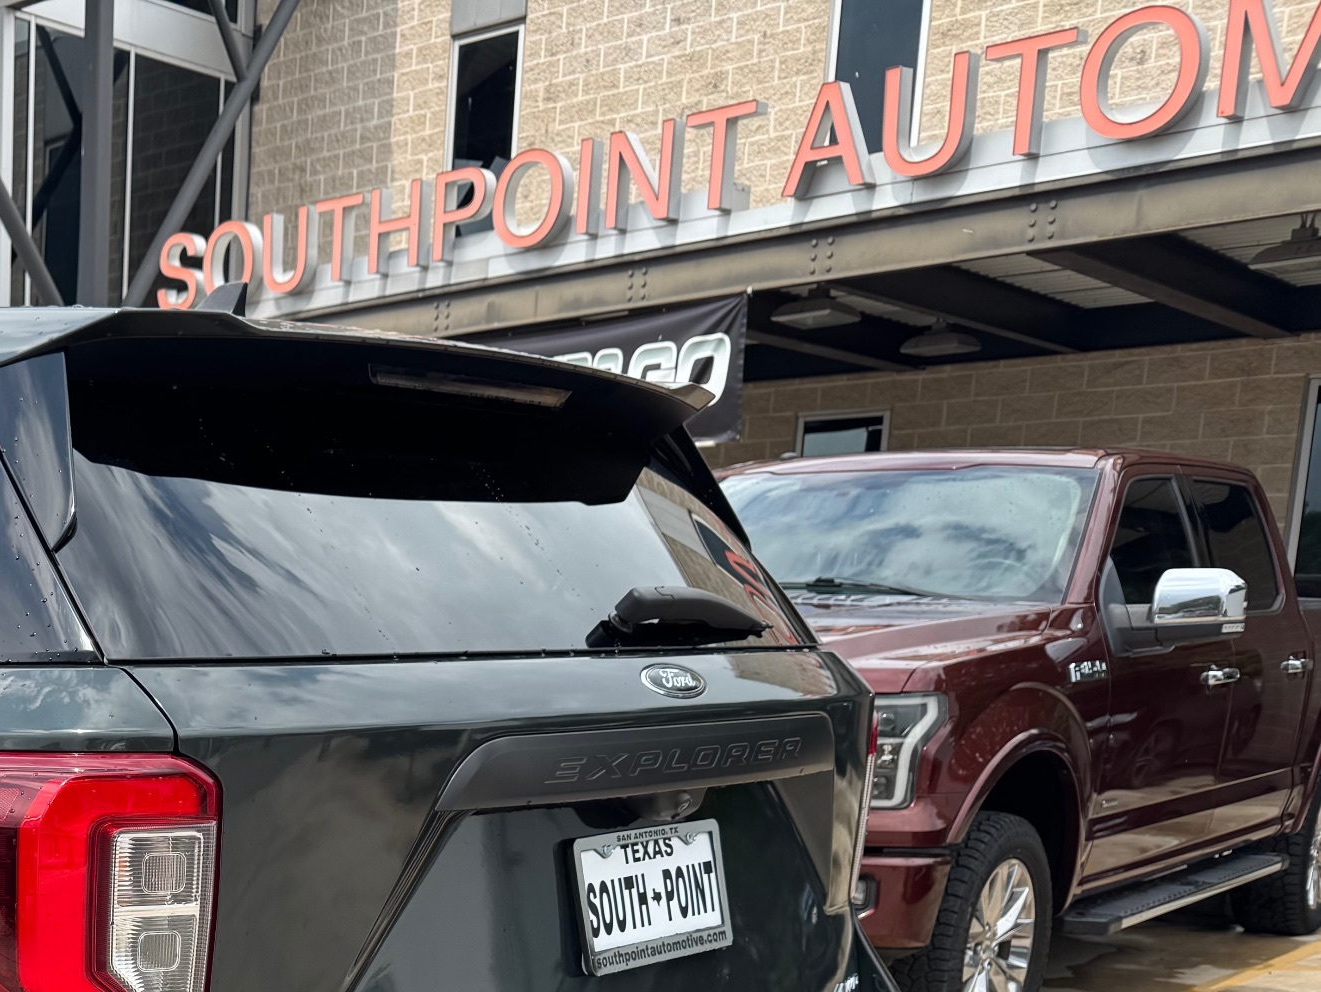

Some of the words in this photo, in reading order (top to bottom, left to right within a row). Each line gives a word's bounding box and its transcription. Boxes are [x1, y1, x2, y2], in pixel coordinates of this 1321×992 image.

[157, 98, 766, 311] SOUTHPOINT
[659, 669, 696, 688] Ford
[544, 737, 802, 784] EXPLORER
[616, 834, 632, 842] SAN
[620, 837, 674, 864] TEXAS
[586, 873, 652, 938] SOUTH
[662, 860, 716, 922] POINT
[596, 930, 727, 968] southpointautomotive.com
